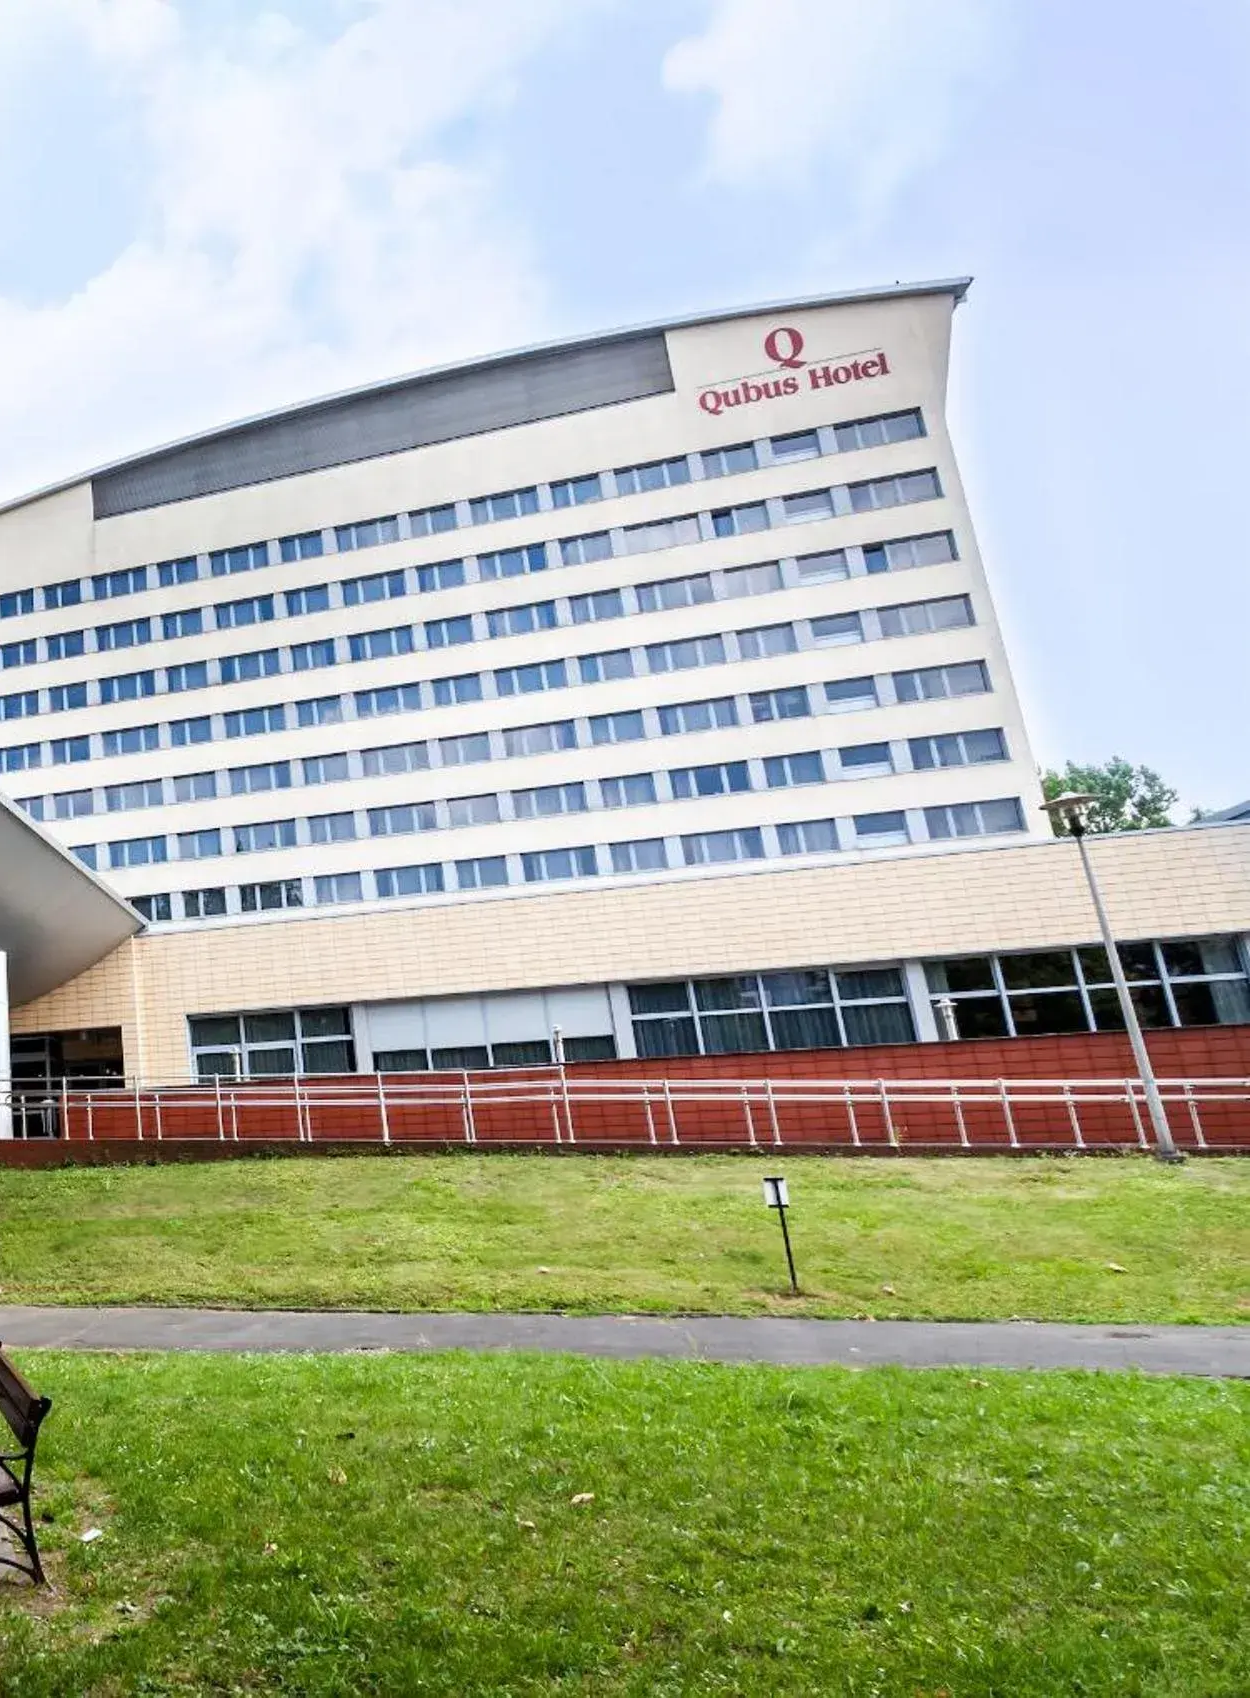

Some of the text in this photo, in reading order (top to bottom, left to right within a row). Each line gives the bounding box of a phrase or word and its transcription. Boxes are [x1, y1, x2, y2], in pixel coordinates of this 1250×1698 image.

[764, 327, 807, 368] Q
[699, 352, 890, 415] Qubus Hotel
